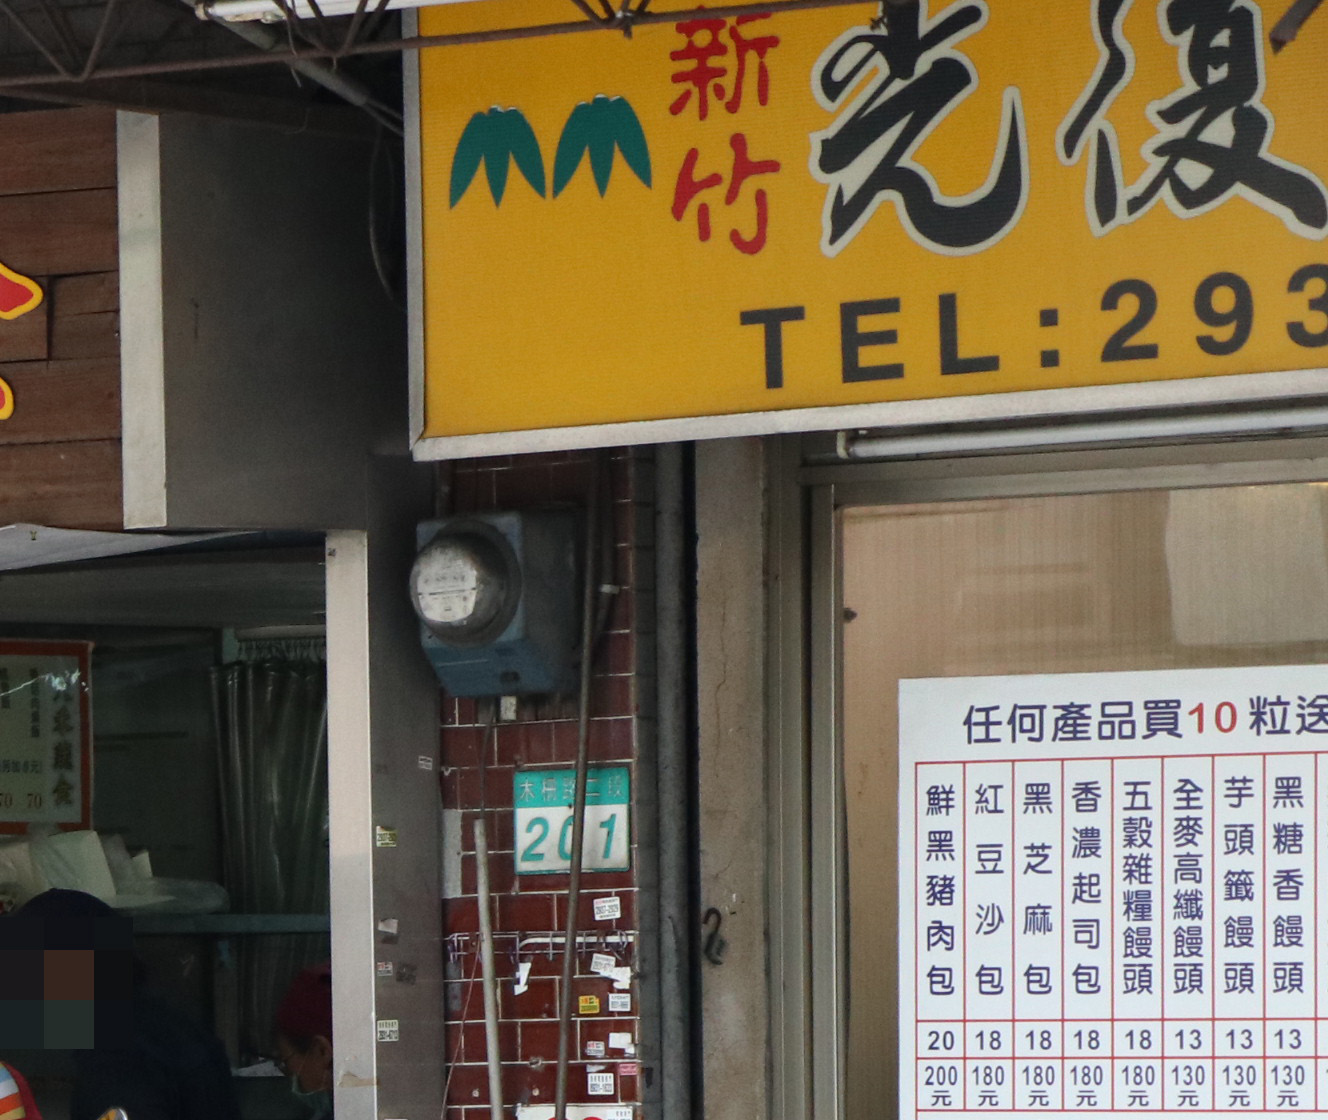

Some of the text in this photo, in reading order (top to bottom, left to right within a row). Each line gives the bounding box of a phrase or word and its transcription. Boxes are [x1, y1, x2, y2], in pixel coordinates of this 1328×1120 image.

[670, 6, 781, 256] 新竹
[810, 0, 1328, 258] 光復
[26, 793, 42, 809] 70
[521, 813, 616, 862] 201
[926, 784, 955, 995] 鮮黑豬肉包
[975, 783, 1004, 995] 紅豆沙包
[1023, 783, 1052, 995] 黑芝麻包
[1072, 781, 1102, 994] 香濃起司包
[1123, 781, 1152, 995] 五穀雜糧饅頭
[1173, 779, 1203, 994] 全麥高纖饅頭
[1224, 776, 1254, 994] 芋頭籤饅頭
[1273, 776, 1304, 993] 黑糖香饅頭
[925, 1065, 1305, 1086] 200 180 180 180 180 130 130 130
[928, 1030, 1302, 1050] 20 18 18 18 18 13 13 13
[931, 1091, 1298, 1107] 元 元 元 元 元 元 元 元
